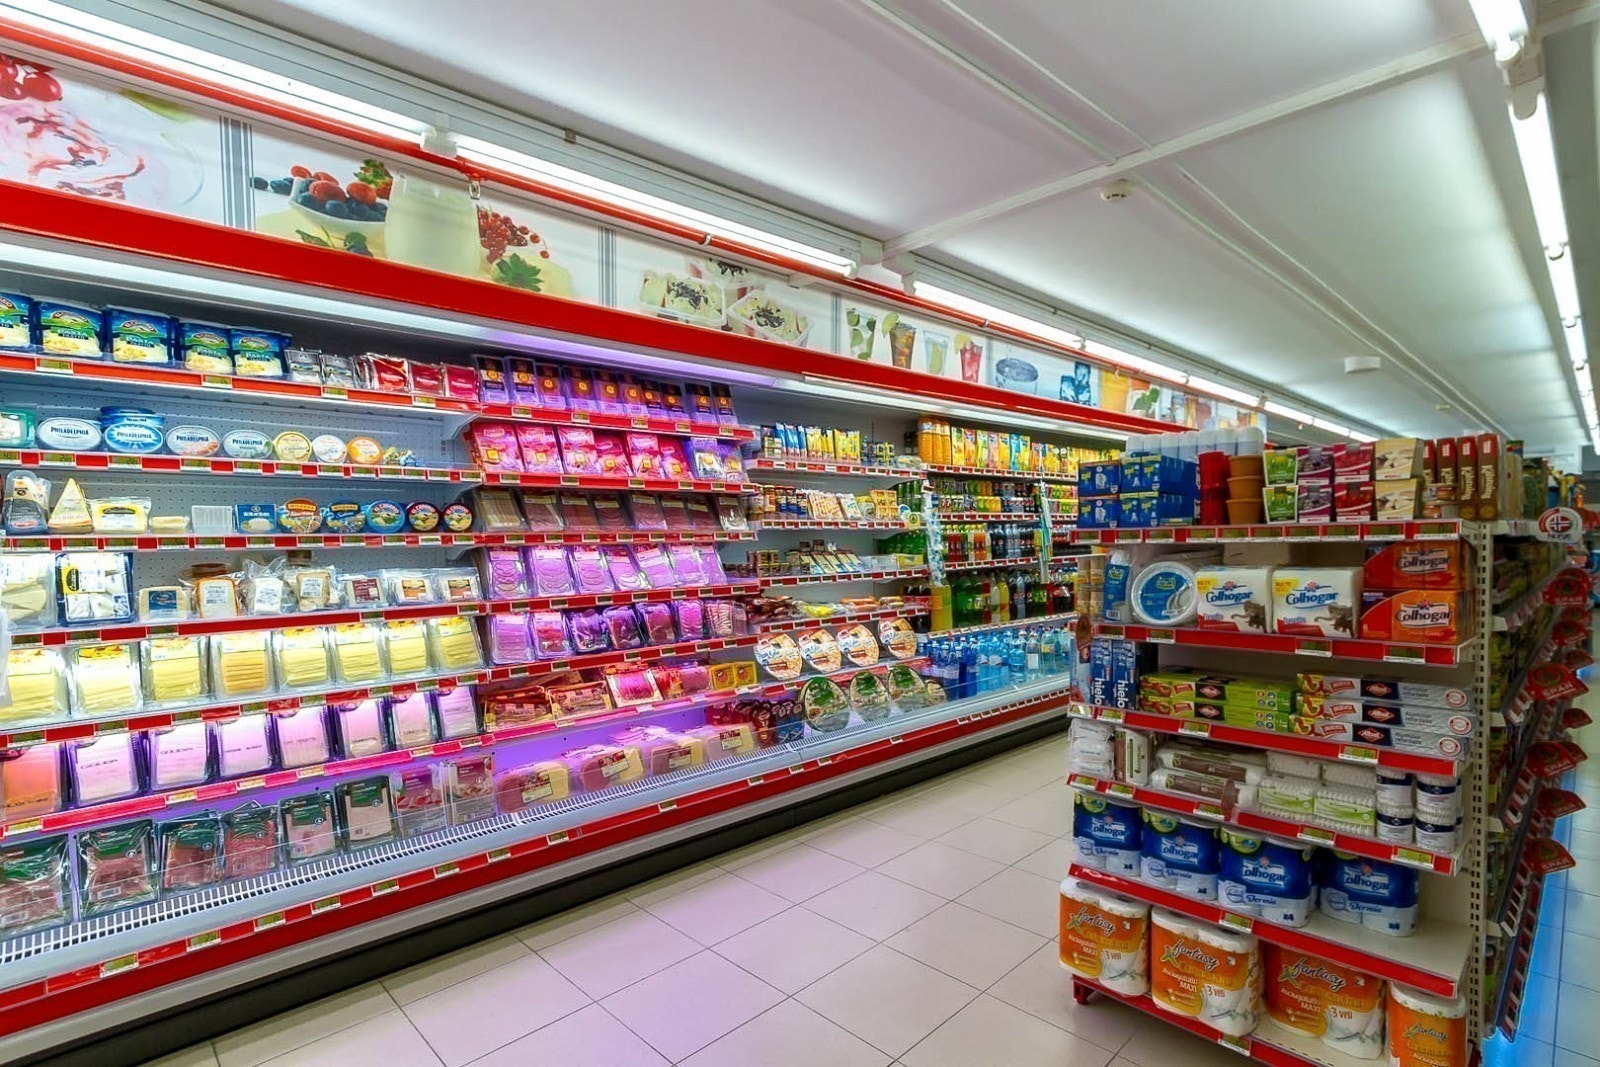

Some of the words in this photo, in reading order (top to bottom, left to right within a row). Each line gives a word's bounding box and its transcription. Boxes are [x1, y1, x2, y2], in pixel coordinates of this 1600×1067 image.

[51, 426, 89, 436] PHILADELPHIA
[116, 431, 152, 439] PHILADELPHIA
[232, 438, 262, 446] PHILADELPHIA
[1396, 557, 1451, 570] Colhogar
[1206, 591, 1253, 603] Colhogar
[1286, 592, 1338, 605] Colhogar
[1396, 610, 1452, 622] Colhogar
[1095, 678, 1105, 705] hielo
[1117, 679, 1128, 708] hielo
[1542, 681, 1573, 697] SPAR
[1369, 709, 1391, 718] Albal
[1362, 730, 1380, 738] Albal
[1159, 844, 1199, 859] olhogar
[1240, 866, 1287, 882] olhogar
[1341, 871, 1390, 890] olhogar
[1077, 907, 1116, 937] fantasy
[1283, 911, 1294, 921] x4
[1082, 946, 1098, 956] MAXI
[1105, 951, 1111, 960] 3
[1173, 939, 1220, 971] fantasy
[1292, 957, 1347, 992] fantasy
[1180, 980, 1197, 993] MAXI
[1207, 985, 1213, 996] 3
[1300, 1001, 1321, 1012] MAXI
[1330, 1006, 1338, 1017] 3
[1338, 1010, 1353, 1020] veli
[1411, 1022, 1449, 1043] fantasy
